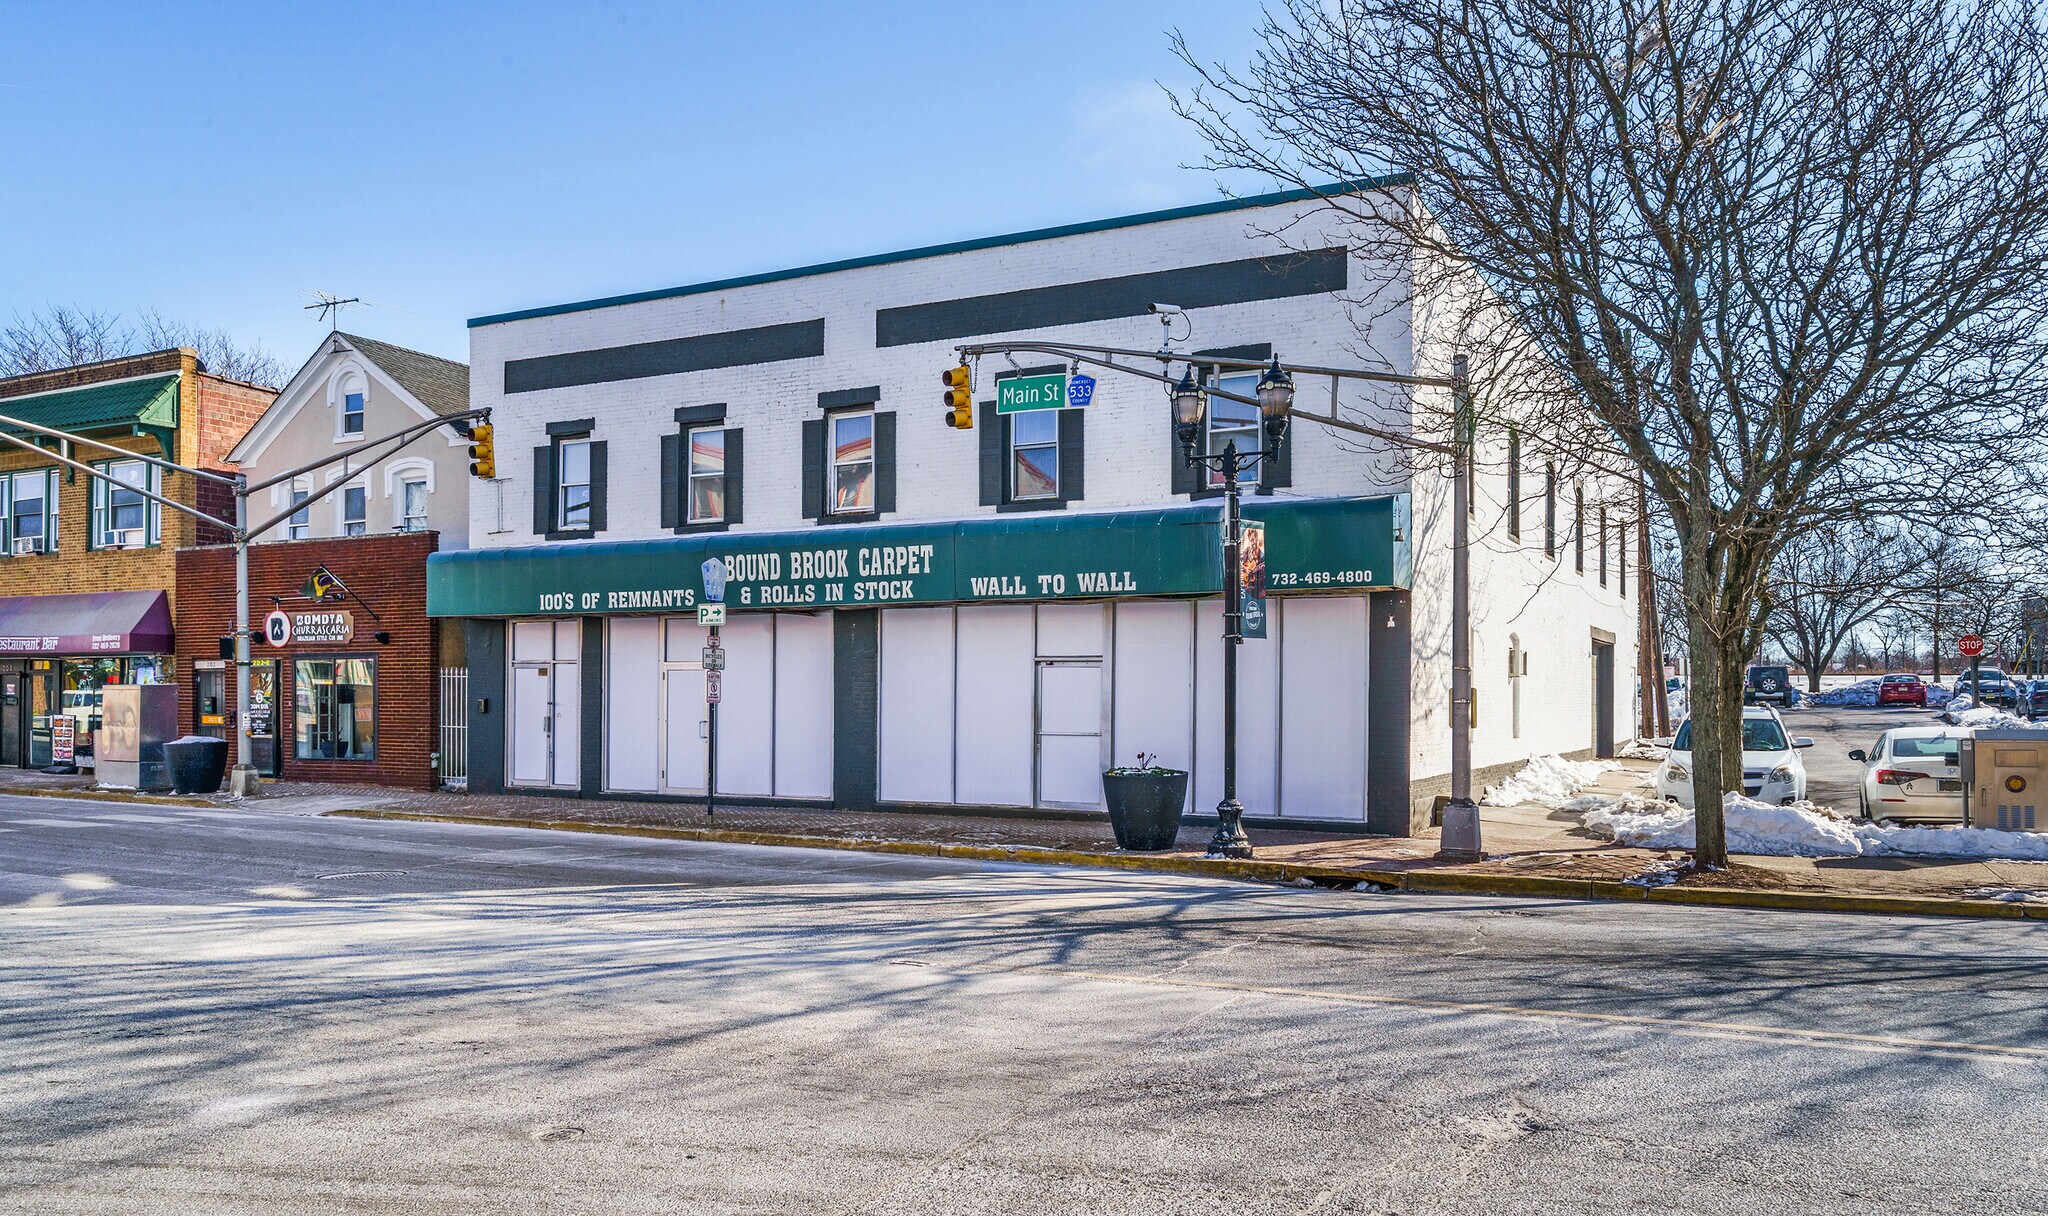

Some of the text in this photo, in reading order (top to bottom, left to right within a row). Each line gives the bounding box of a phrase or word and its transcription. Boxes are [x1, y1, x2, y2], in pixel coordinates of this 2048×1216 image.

[1003, 384, 1059, 405] Main St
[1070, 386, 1091, 398] 533
[725, 553, 781, 582] BOUND
[791, 550, 849, 580] BROOK
[859, 545, 933, 577] CARPET
[971, 571, 1136, 596] WALL TO WALL
[1272, 570, 1372, 585] 732-469-4800
[741, 580, 914, 604] & ROLLS IN STOCK
[540, 589, 694, 611] 100'S OF REMNANTS
[700, 608, 709, 623] P
[292, 625, 350, 636] CHURRASCARIA
[0, 637, 59, 650] estaurant Bar
[1960, 640, 1982, 649] STOP
